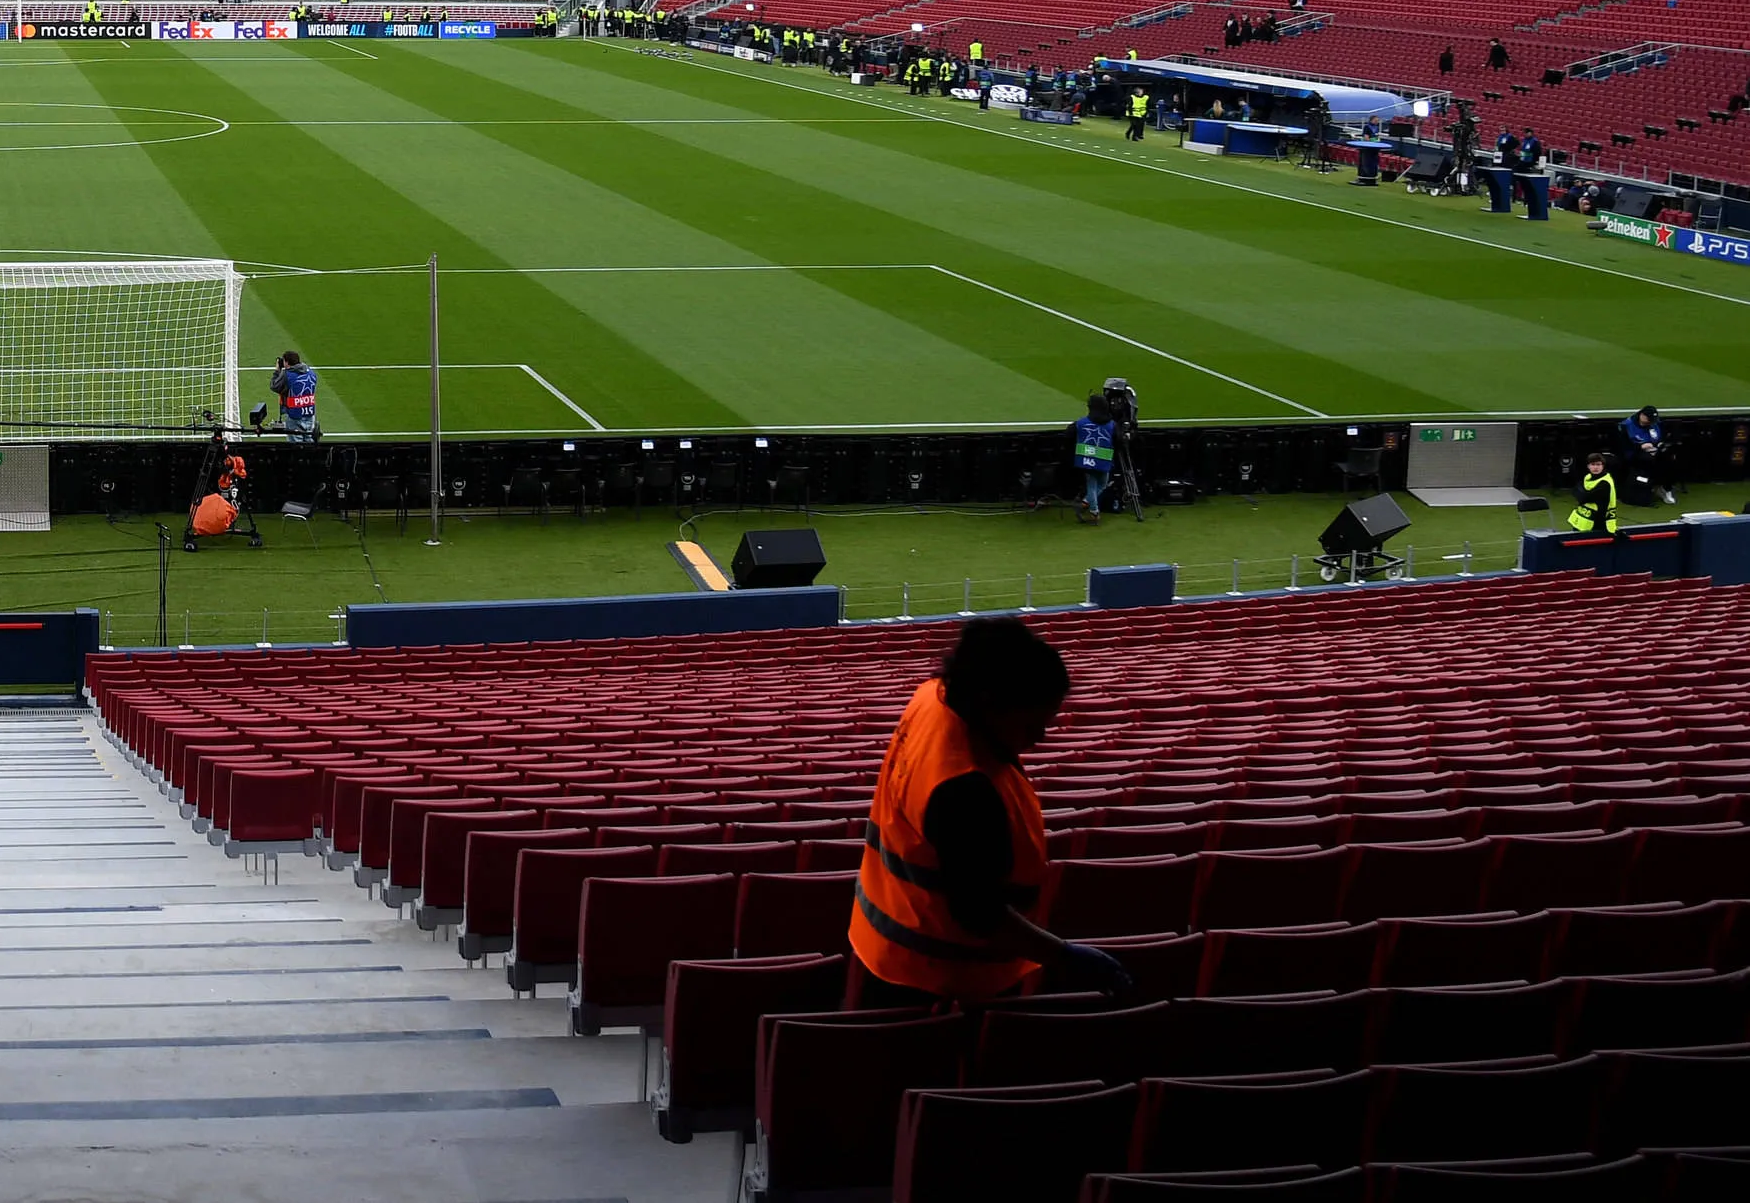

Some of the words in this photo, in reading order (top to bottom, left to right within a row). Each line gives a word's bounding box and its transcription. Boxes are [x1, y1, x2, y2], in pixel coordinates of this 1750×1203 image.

[40, 23, 146, 36] mastercard
[158, 22, 214, 39] FedEx
[233, 21, 289, 38] FedEx
[308, 23, 348, 36] WELCOME
[348, 23, 366, 36] ALL
[384, 24, 433, 36] #FOOTBALL
[445, 25, 491, 34] RECYCLE
[1600, 214, 1650, 241] Heineken
[1709, 238, 1749, 260] PS5
